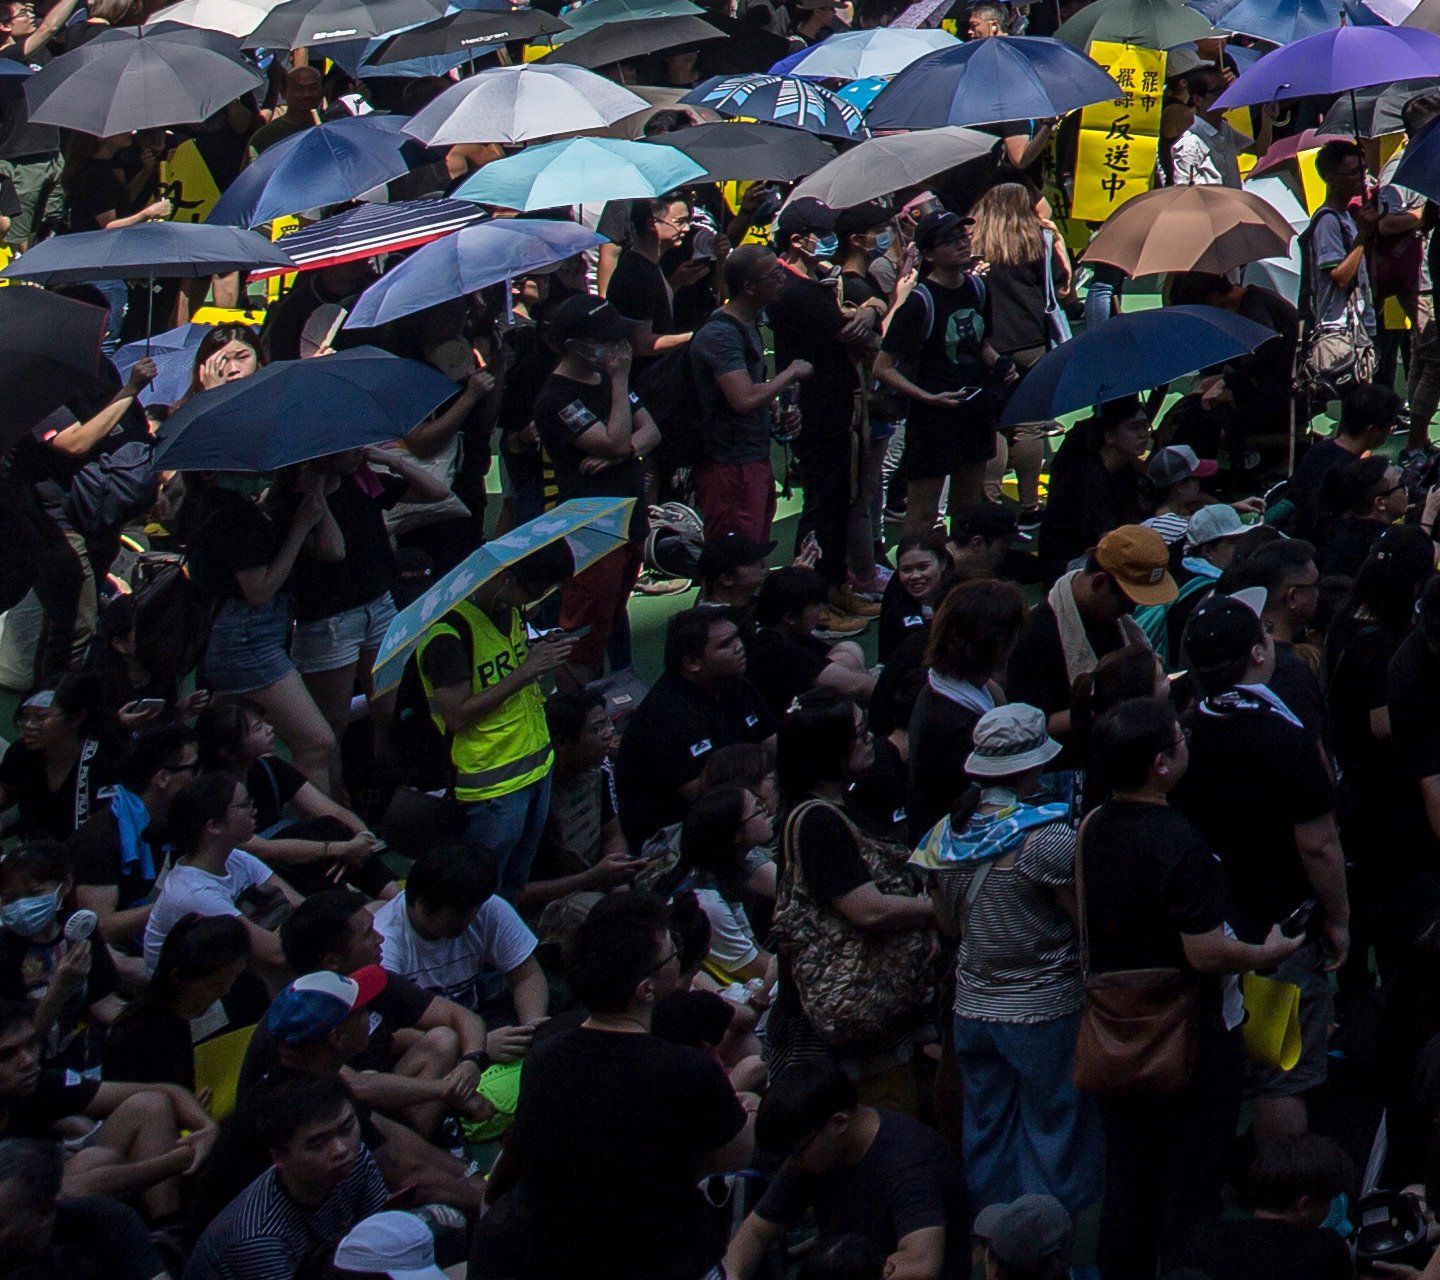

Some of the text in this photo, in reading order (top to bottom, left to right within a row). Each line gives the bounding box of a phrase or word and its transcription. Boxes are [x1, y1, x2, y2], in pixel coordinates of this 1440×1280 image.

[1141, 70, 1158, 112] 罷市
[1100, 114, 1134, 201] 反送中
[477, 643, 530, 687] PRE
